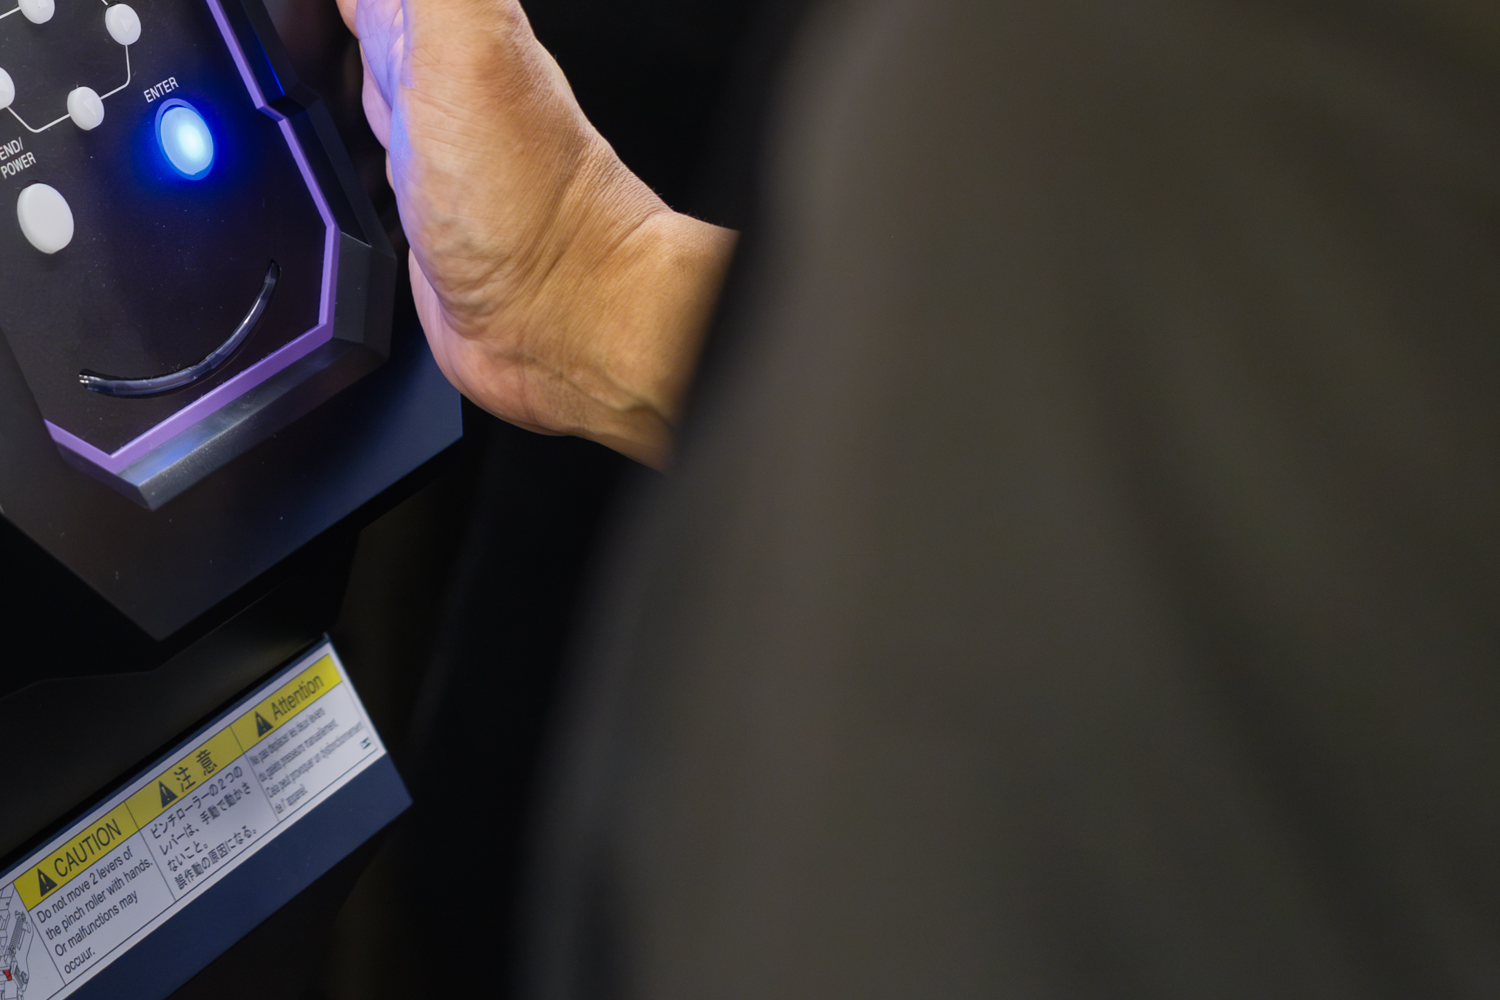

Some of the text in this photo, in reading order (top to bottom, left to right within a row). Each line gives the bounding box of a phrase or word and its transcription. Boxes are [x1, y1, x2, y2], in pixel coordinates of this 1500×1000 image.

[143, 76, 179, 103] ENTER
[0, 151, 37, 179] POWER
[271, 675, 325, 721] Attention
[173, 749, 218, 793] 注意
[54, 818, 122, 877] CAUTION
[36, 846, 134, 924] Do not move 2 levers of
[45, 857, 154, 941] the pinch roller with hands.
[54, 890, 138, 957] Or malfunctions may
[64, 945, 96, 974] occuur.
